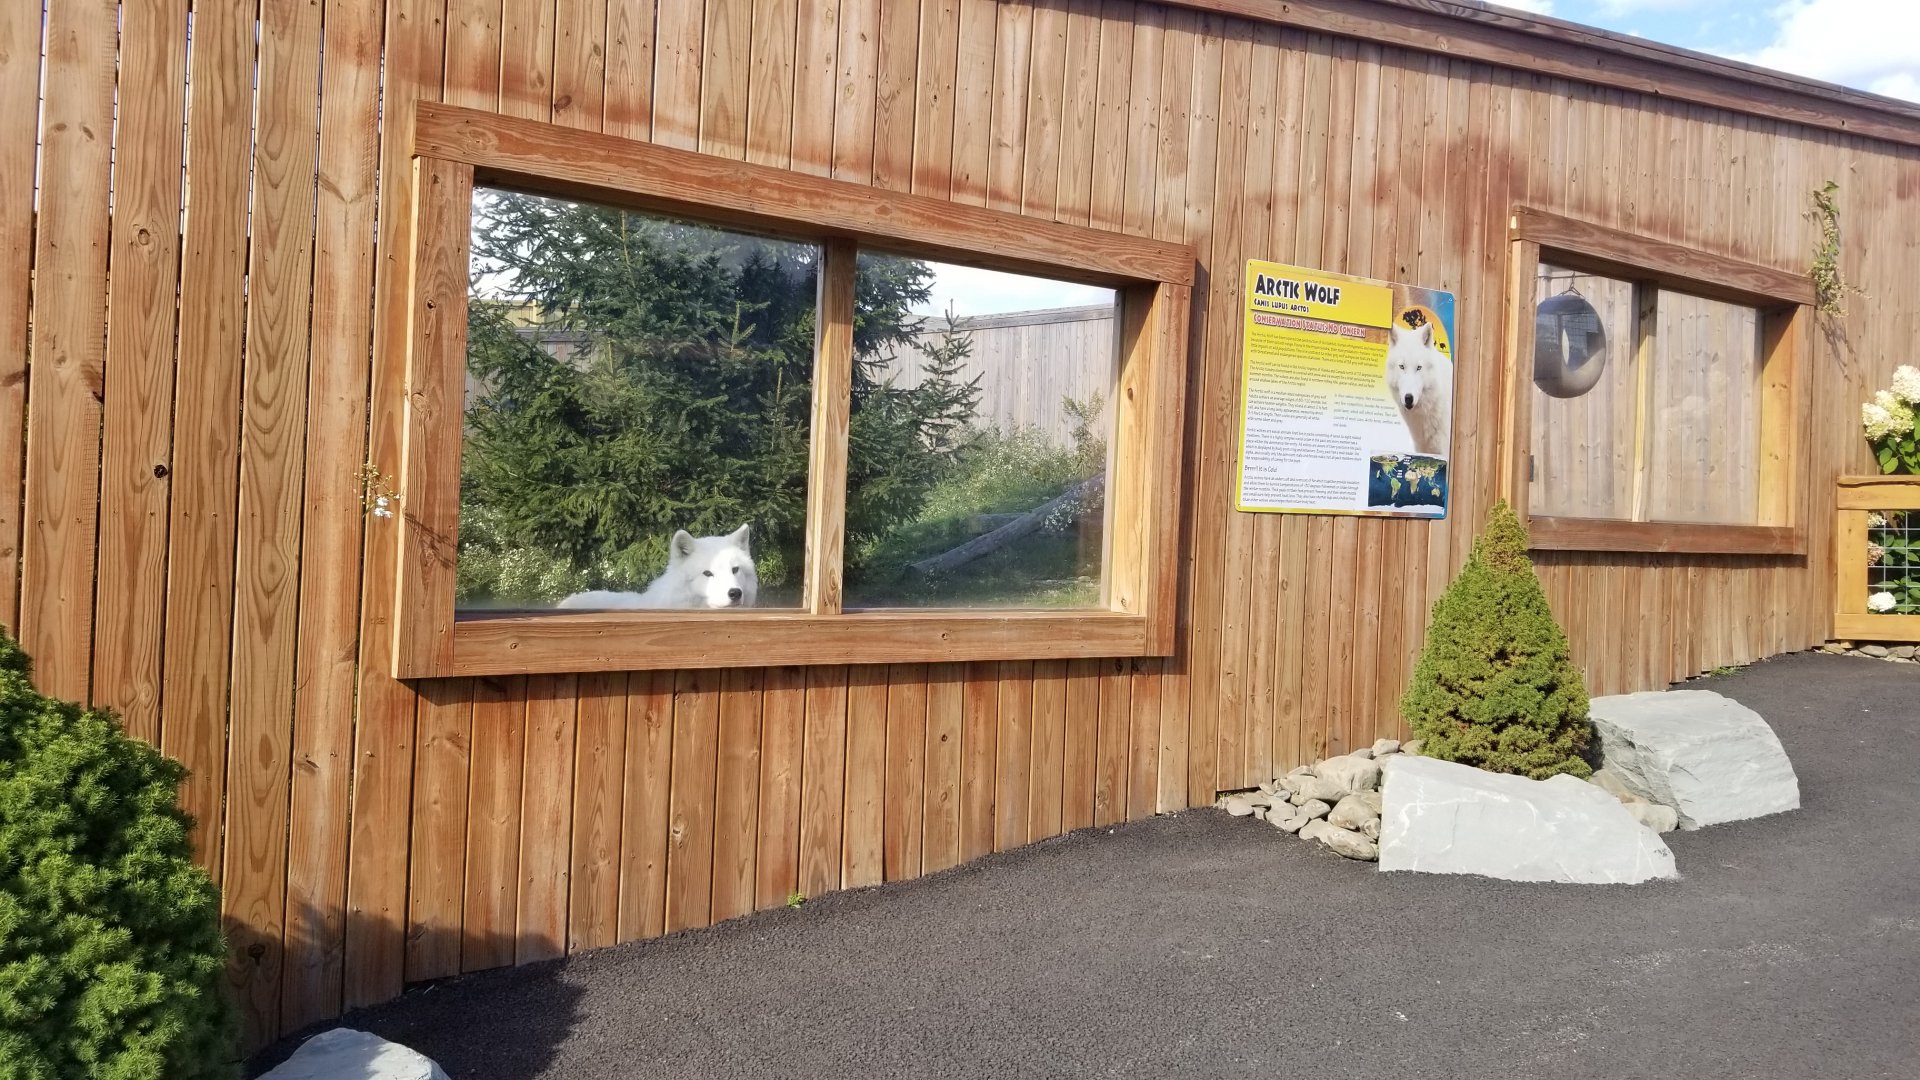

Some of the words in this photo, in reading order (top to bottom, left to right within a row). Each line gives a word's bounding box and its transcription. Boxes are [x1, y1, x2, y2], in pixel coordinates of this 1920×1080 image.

[1254, 274, 1300, 300] ARCTIC
[1304, 282, 1340, 305] WOLF
[1254, 298, 1270, 308] CANIS
[1272, 302, 1288, 310] LUPUS
[1254, 314, 1301, 328] CONSERVATION
[1328, 324, 1338, 334] NO
[1340, 326, 1366, 338] CONCERN
